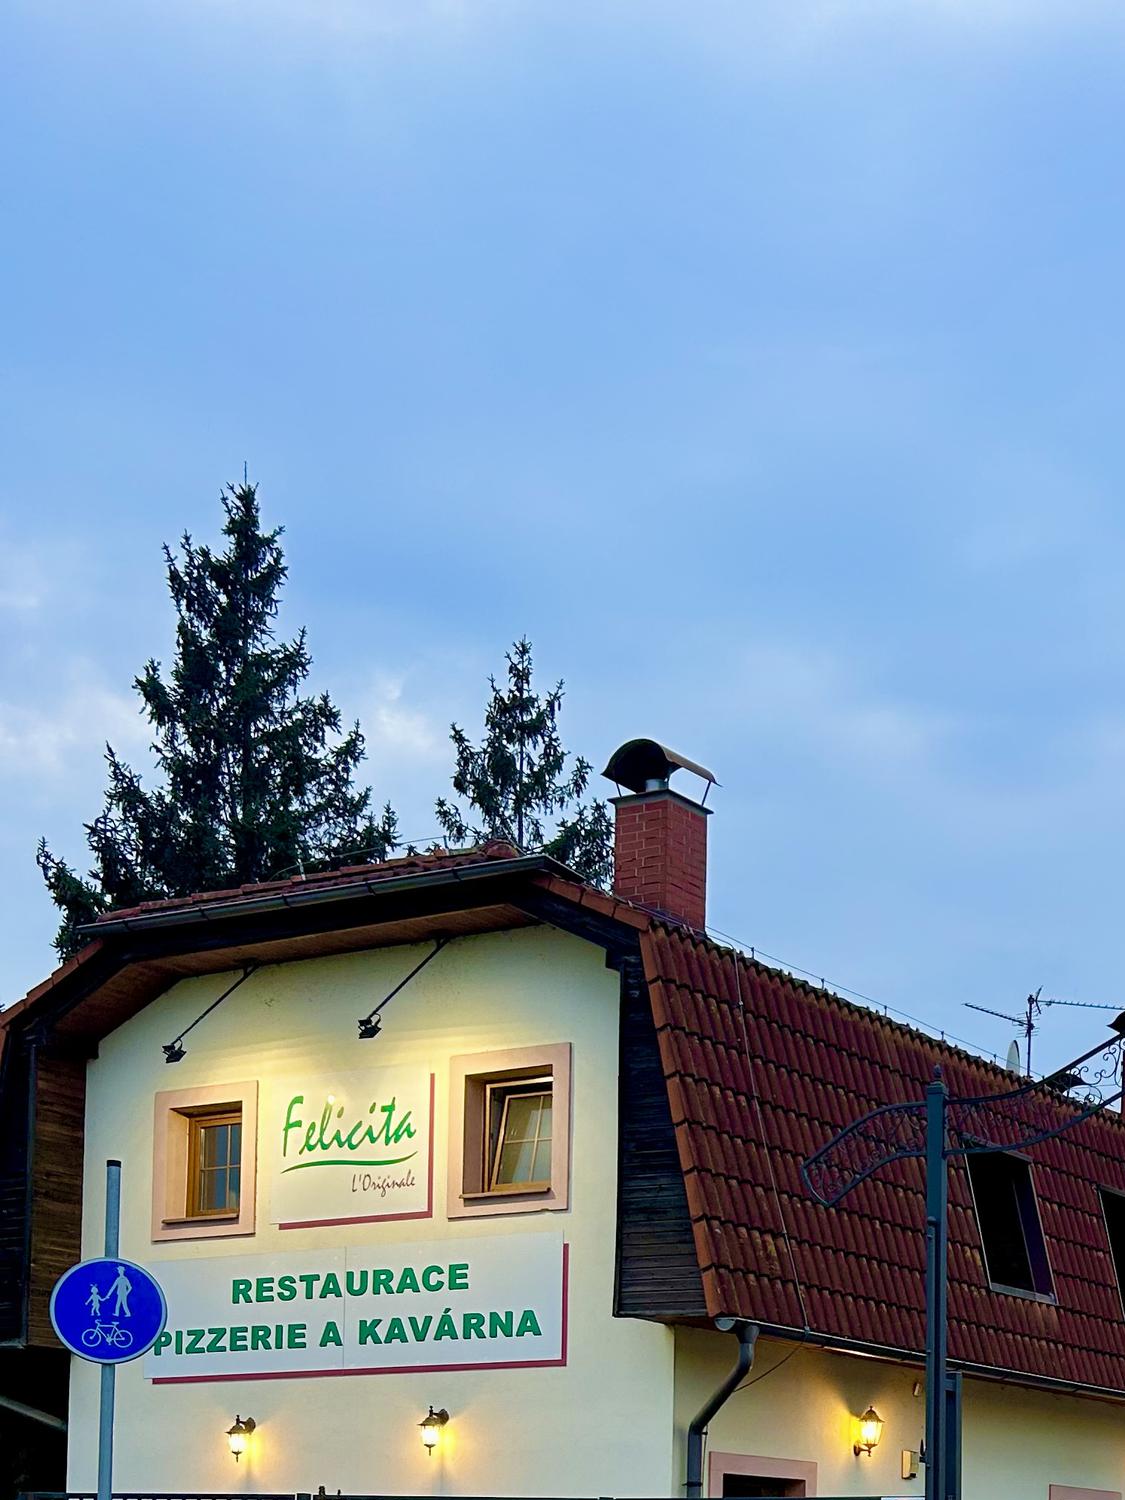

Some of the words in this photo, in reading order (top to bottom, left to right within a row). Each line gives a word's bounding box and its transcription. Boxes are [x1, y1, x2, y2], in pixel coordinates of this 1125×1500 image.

[282, 1095, 417, 1157] Felicita
[351, 1169, 416, 1197] L'Originale
[231, 1263, 469, 1304] RESTAURACE
[154, 1323, 307, 1356] PIZZERIE
[319, 1321, 343, 1347] A
[358, 1308, 542, 1345] KAVÁRNA
